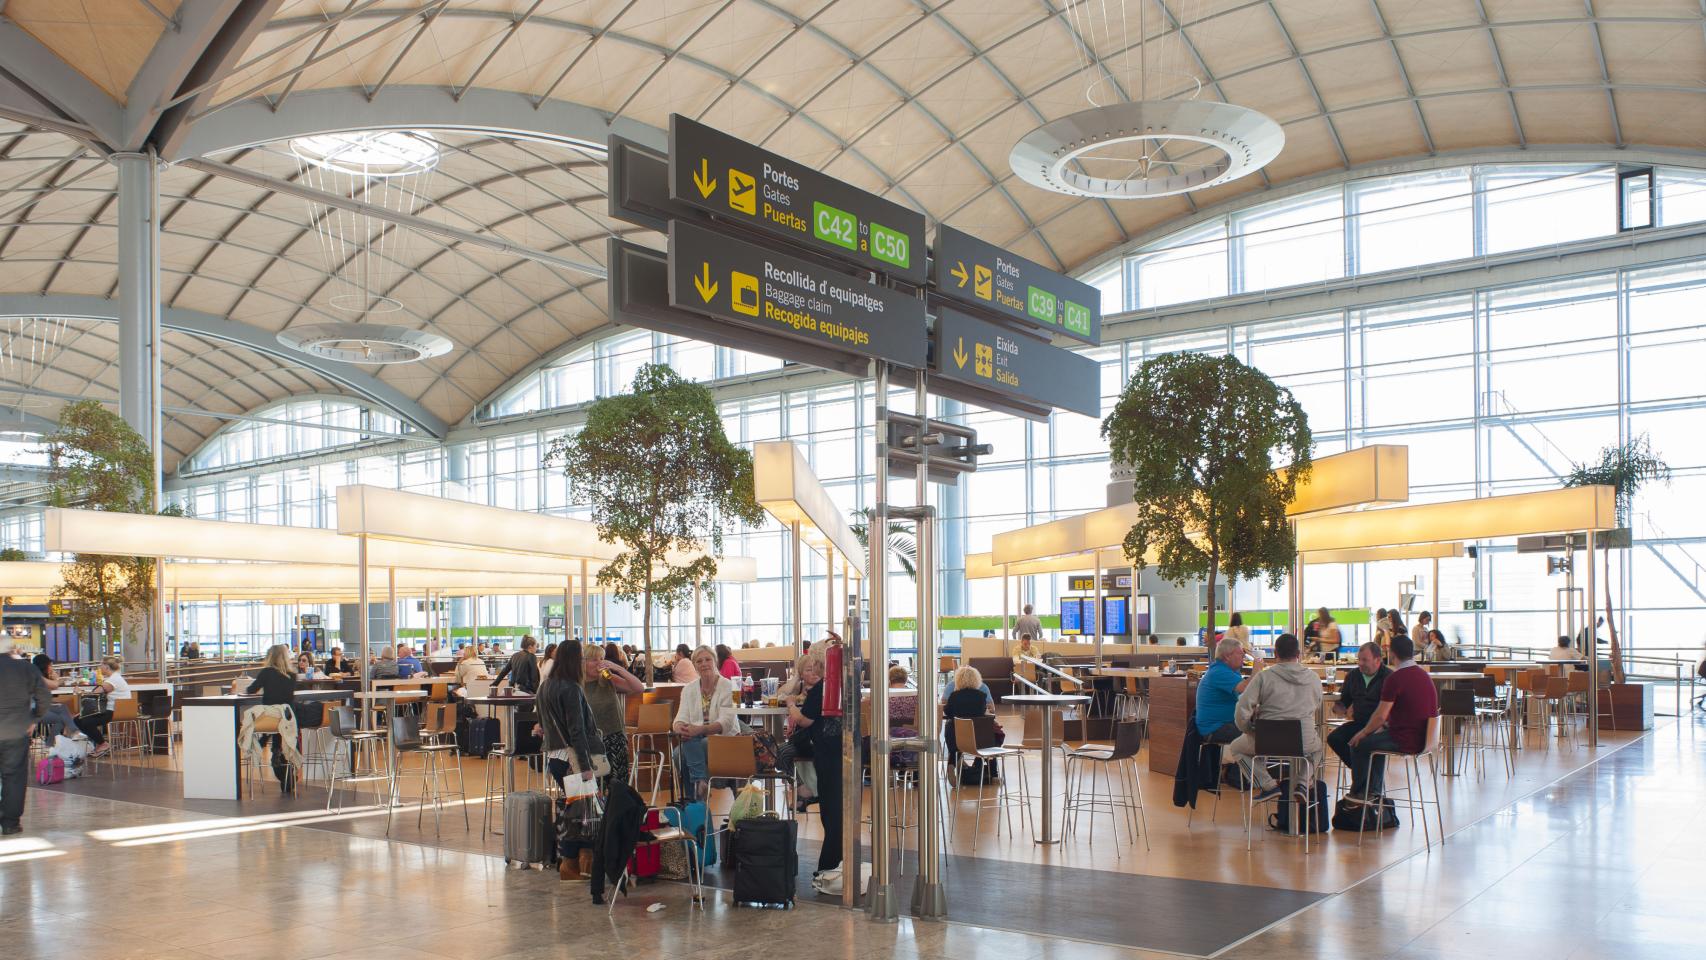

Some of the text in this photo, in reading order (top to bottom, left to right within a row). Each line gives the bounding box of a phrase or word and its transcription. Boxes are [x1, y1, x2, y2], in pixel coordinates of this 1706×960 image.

[764, 163, 799, 190] Portes
[764, 184, 790, 205] Gates
[764, 203, 806, 232] Puertas
[818, 211, 905, 262] C42 to C50
[861, 239, 867, 252] a
[765, 262, 815, 293] Recollida
[996, 258, 1020, 278] Portes
[997, 275, 1014, 291] Gates
[765, 283, 832, 315] Baggage claim
[996, 291, 1024, 311] Puertas
[1032, 293, 1087, 330] C39 to C41
[1058, 315, 1062, 324] a
[765, 303, 869, 345] Recogida equipajes
[997, 337, 1018, 355] Eixida
[997, 354, 1008, 367] Exit
[996, 369, 1019, 387] Salida
[899, 621, 915, 629] C40
